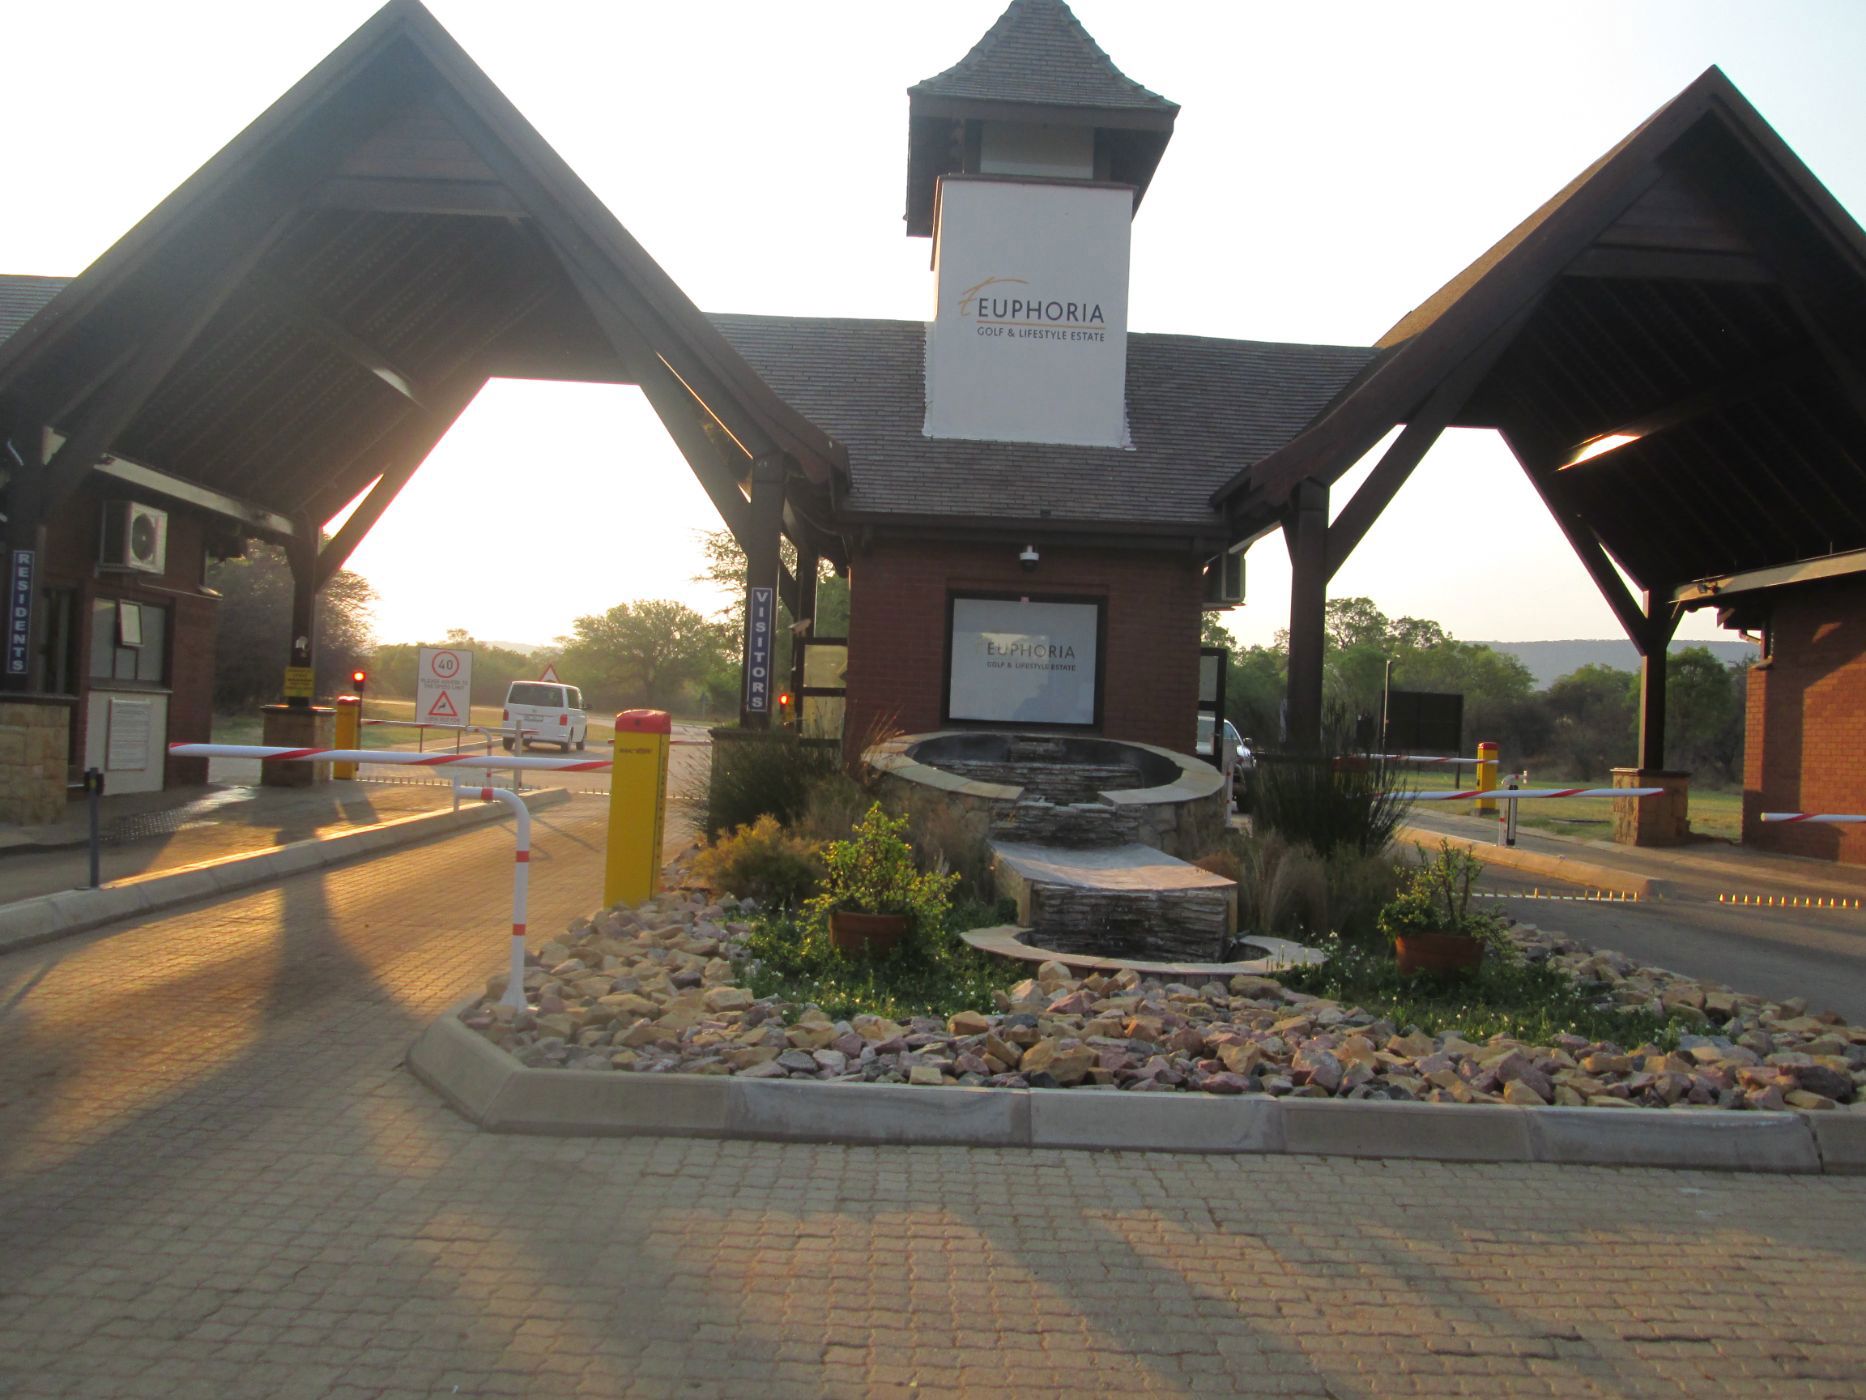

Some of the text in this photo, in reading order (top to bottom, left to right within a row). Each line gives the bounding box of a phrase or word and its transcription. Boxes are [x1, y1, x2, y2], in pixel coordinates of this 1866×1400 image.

[978, 298, 1105, 323] EUPHORIA
[977, 327, 1105, 342] GOLF & LIFESTYLE ESTATE
[12, 553, 31, 672] RESIDENTS
[751, 591, 768, 708] VISITORS
[987, 642, 1076, 659] EUPHORIA
[438, 659, 453, 671] 40
[1050, 664, 1077, 672] ESTATE
